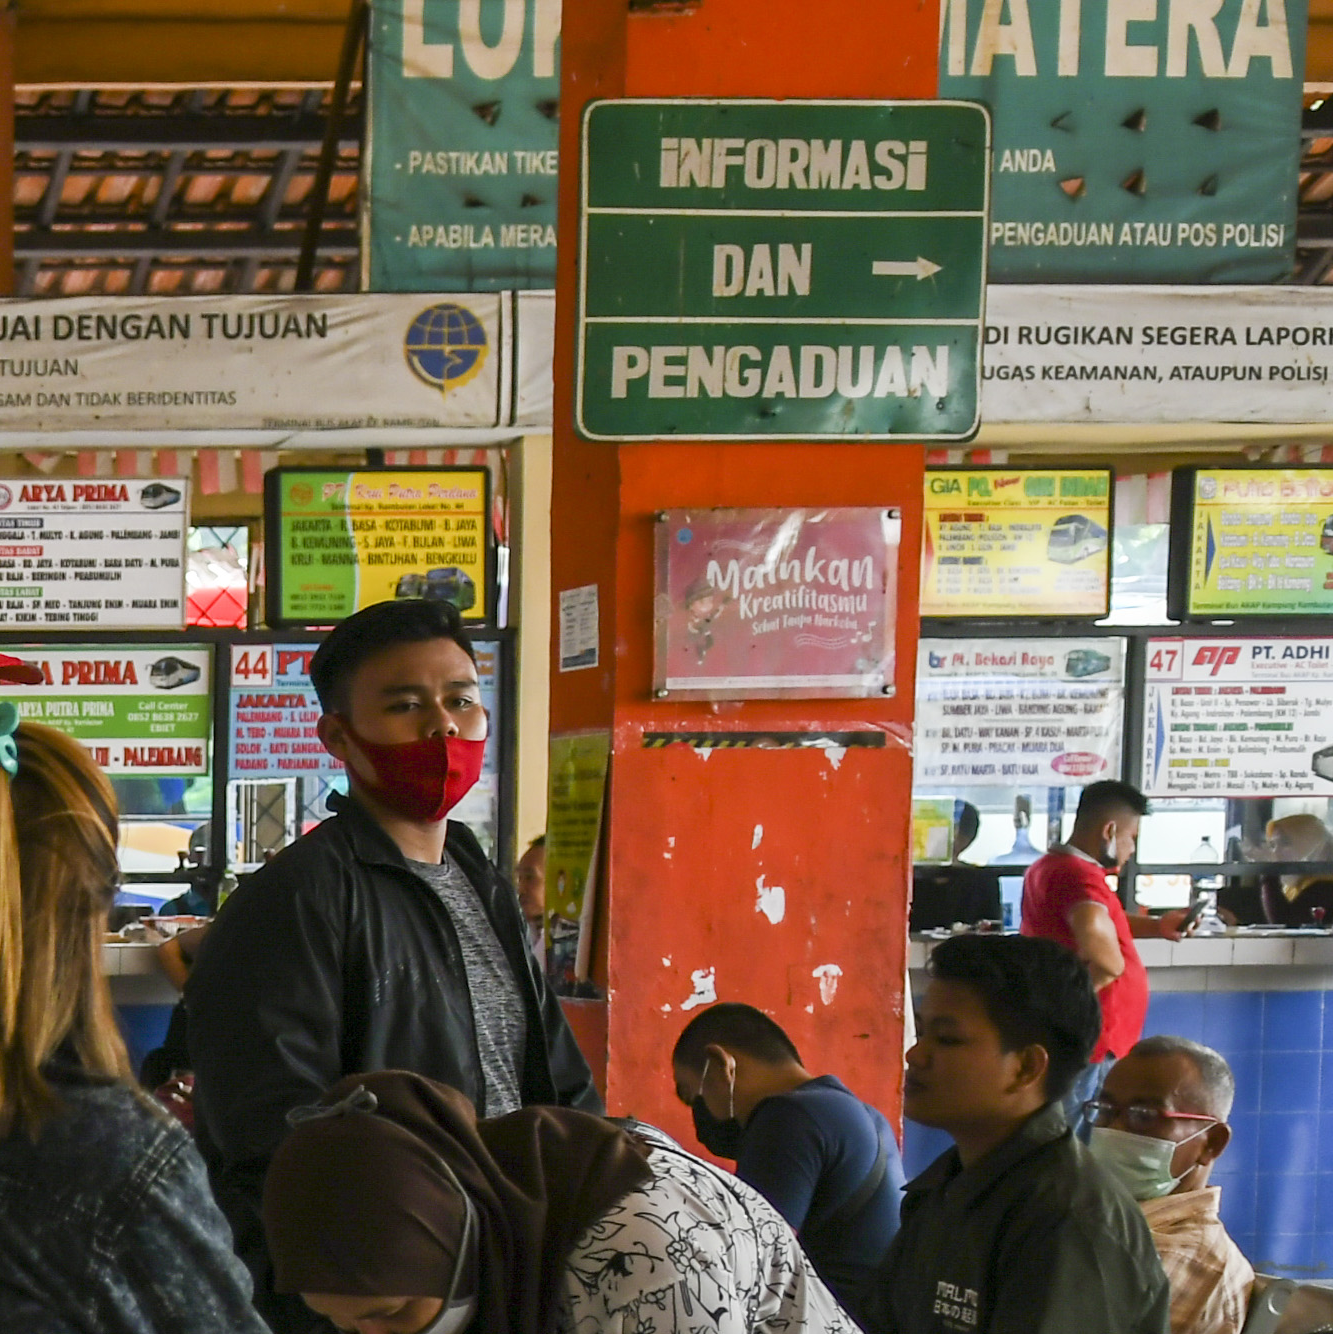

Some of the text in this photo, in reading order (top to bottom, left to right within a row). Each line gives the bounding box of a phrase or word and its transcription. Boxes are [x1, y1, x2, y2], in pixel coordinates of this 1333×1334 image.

[408, 148, 1057, 176] PASTIKAN TIKE ANDA
[407, 222, 1286, 250] APABILA MERA PENGADUAN ATAU POS POLISI
[711, 242, 813, 299] DAN
[51, 312, 193, 341] DENGAN
[201, 311, 329, 341] TUJUAN
[984, 325, 1011, 346] DI
[1017, 325, 1134, 347] RUGIKAN
[1140, 325, 1239, 347] SEGERA
[610, 344, 951, 401] PENGADUAN
[1041, 365, 1330, 383] KEAMANAN, ATAUPUN POLISI
[35, 392, 71, 408] DAN
[74, 392, 123, 408] TIDAK
[126, 391, 238, 408] BERIDENTITAS
[19, 484, 130, 503] ARYA PRIMA
[930, 477, 963, 495] GIA
[739, 585, 869, 621] Kreatifitasmu
[1149, 649, 1179, 673] 47
[1251, 645, 1330, 660] PT. ADHI
[61, 660, 139, 687] PRIMA
[235, 650, 270, 681] 44
[138, 700, 189, 712] Call Center
[236, 693, 307, 709] JAKARTA
[123, 745, 203, 768] PALEMBANG
